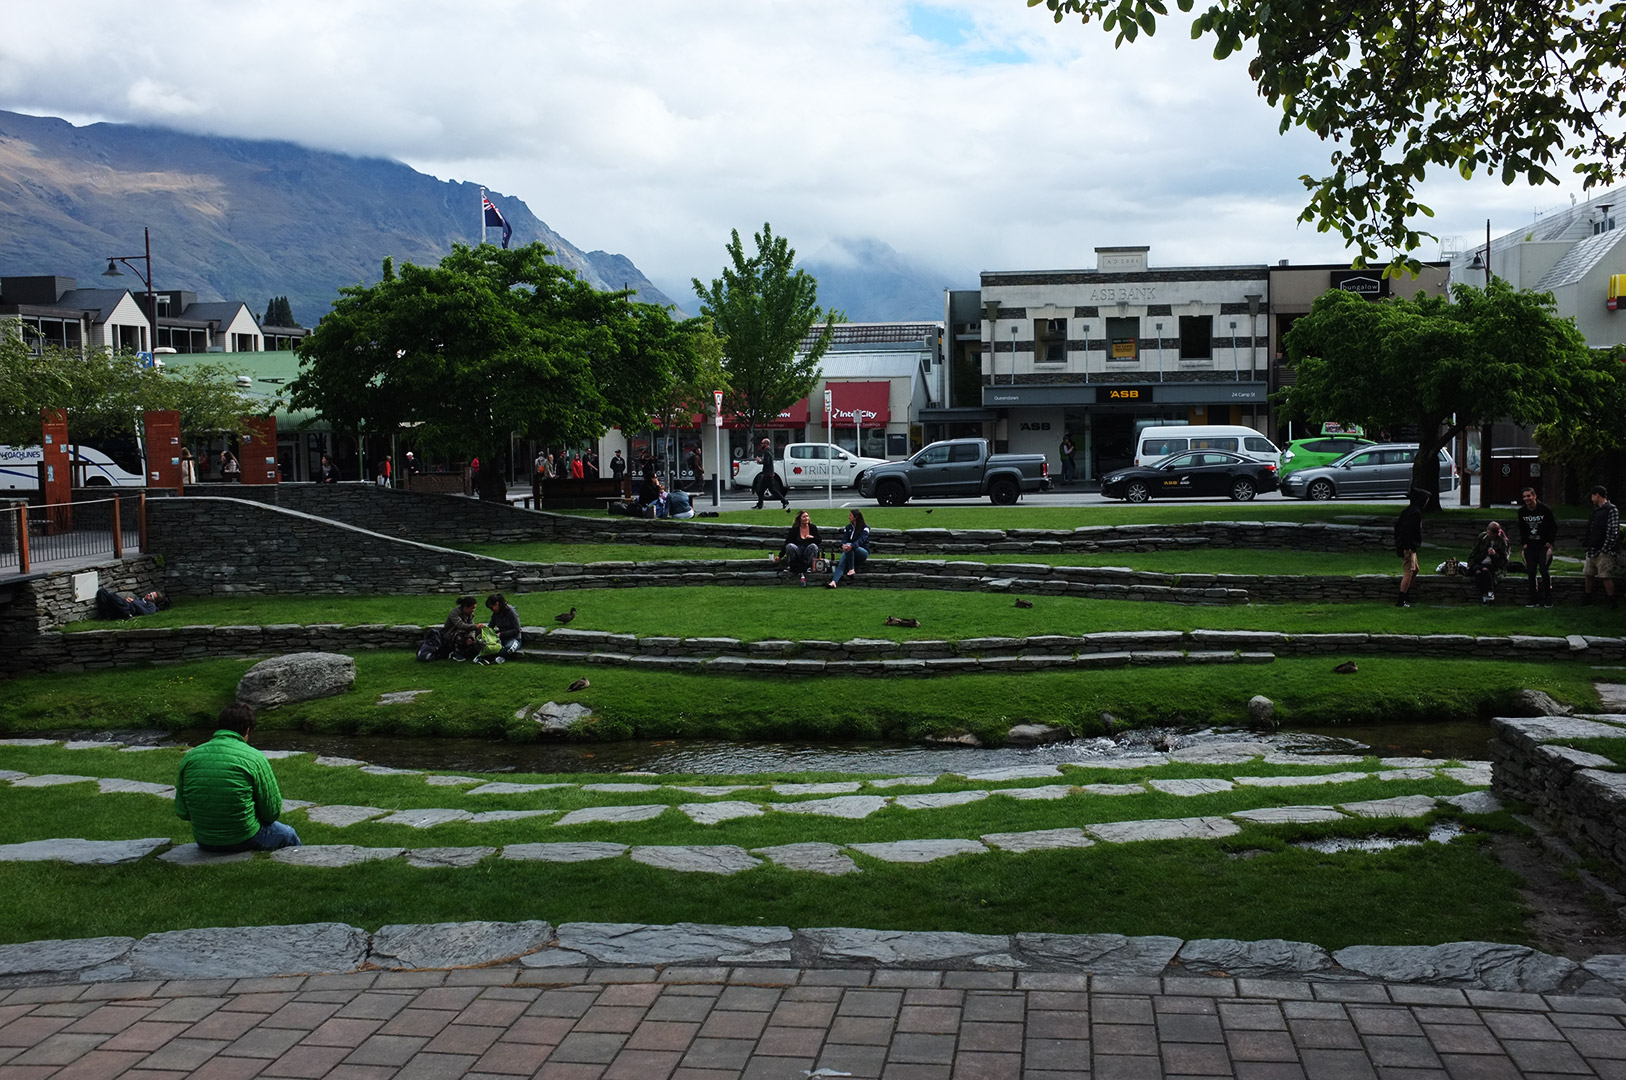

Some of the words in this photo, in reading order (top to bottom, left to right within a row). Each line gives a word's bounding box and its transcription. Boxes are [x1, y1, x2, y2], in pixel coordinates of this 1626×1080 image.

[1342, 283, 1378, 291] bungalow
[1089, 288, 1116, 301] ASB
[1118, 287, 1157, 301] BANK
[1110, 390, 1139, 398] ASB
[840, 410, 877, 419] InteCity
[1020, 422, 1051, 431] ASB
[802, 465, 844, 475] TRINITY
